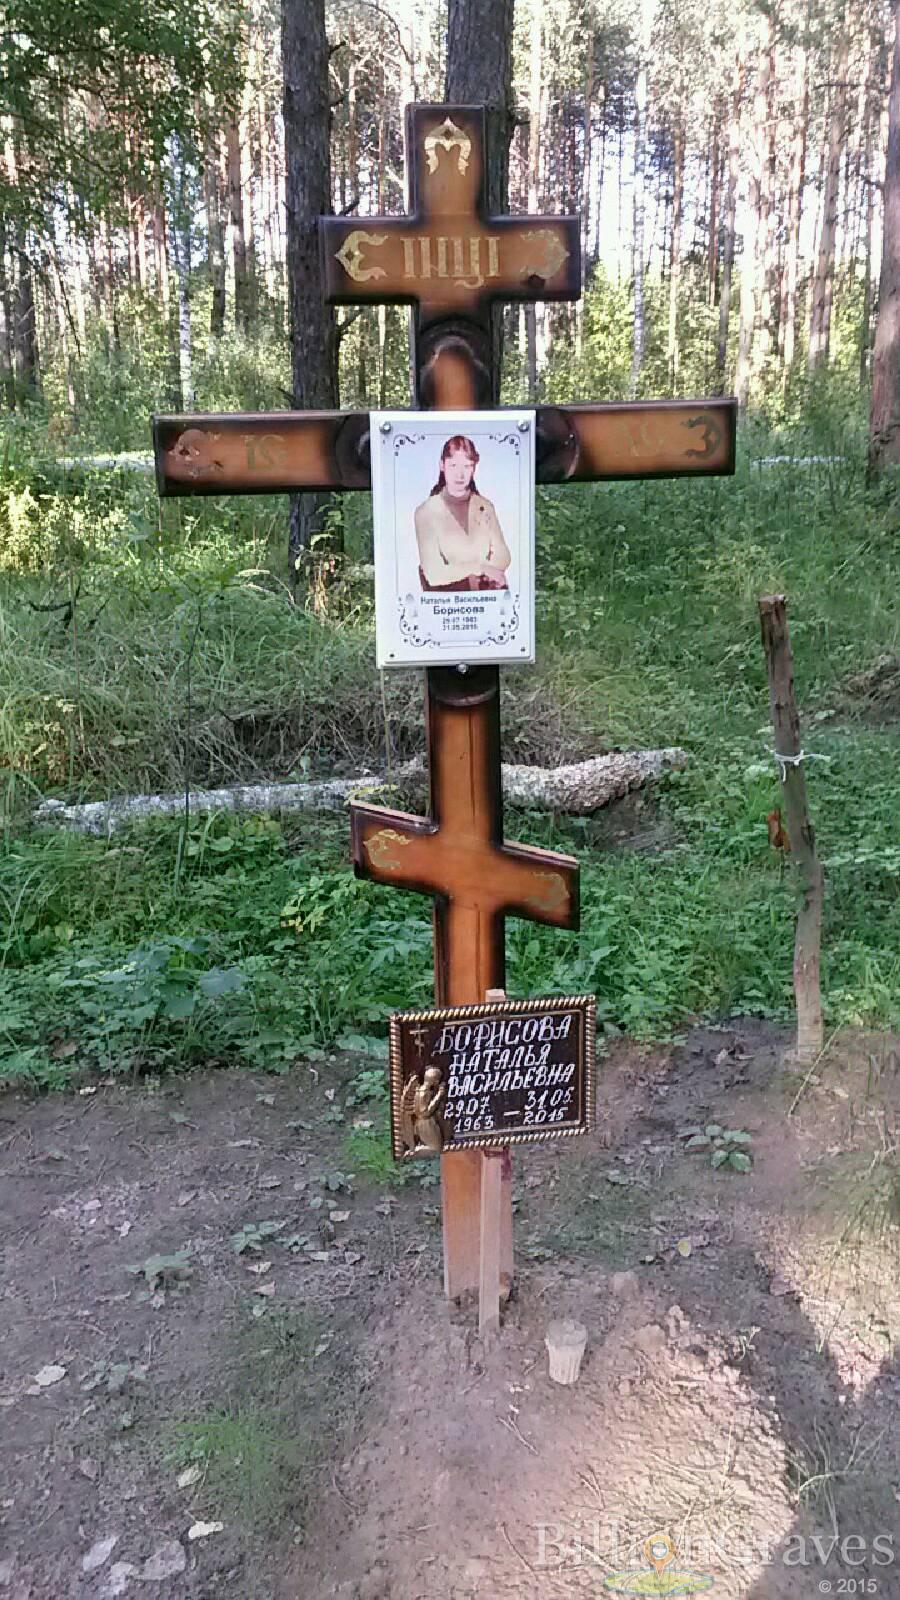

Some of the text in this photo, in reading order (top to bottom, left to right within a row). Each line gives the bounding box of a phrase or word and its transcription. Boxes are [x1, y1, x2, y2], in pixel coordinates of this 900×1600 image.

[420, 595, 497, 605] Наталья Васильевна
[433, 605, 485, 616] Борисова
[431, 1015, 572, 1057] БОРИСОВА
[449, 1043, 552, 1076] НАТАЛЬЯ
[447, 1063, 576, 1098] ВАСИЛЬЕВНА
[454, 1115, 495, 1133] 1963
[523, 1106, 569, 1125] 2015
